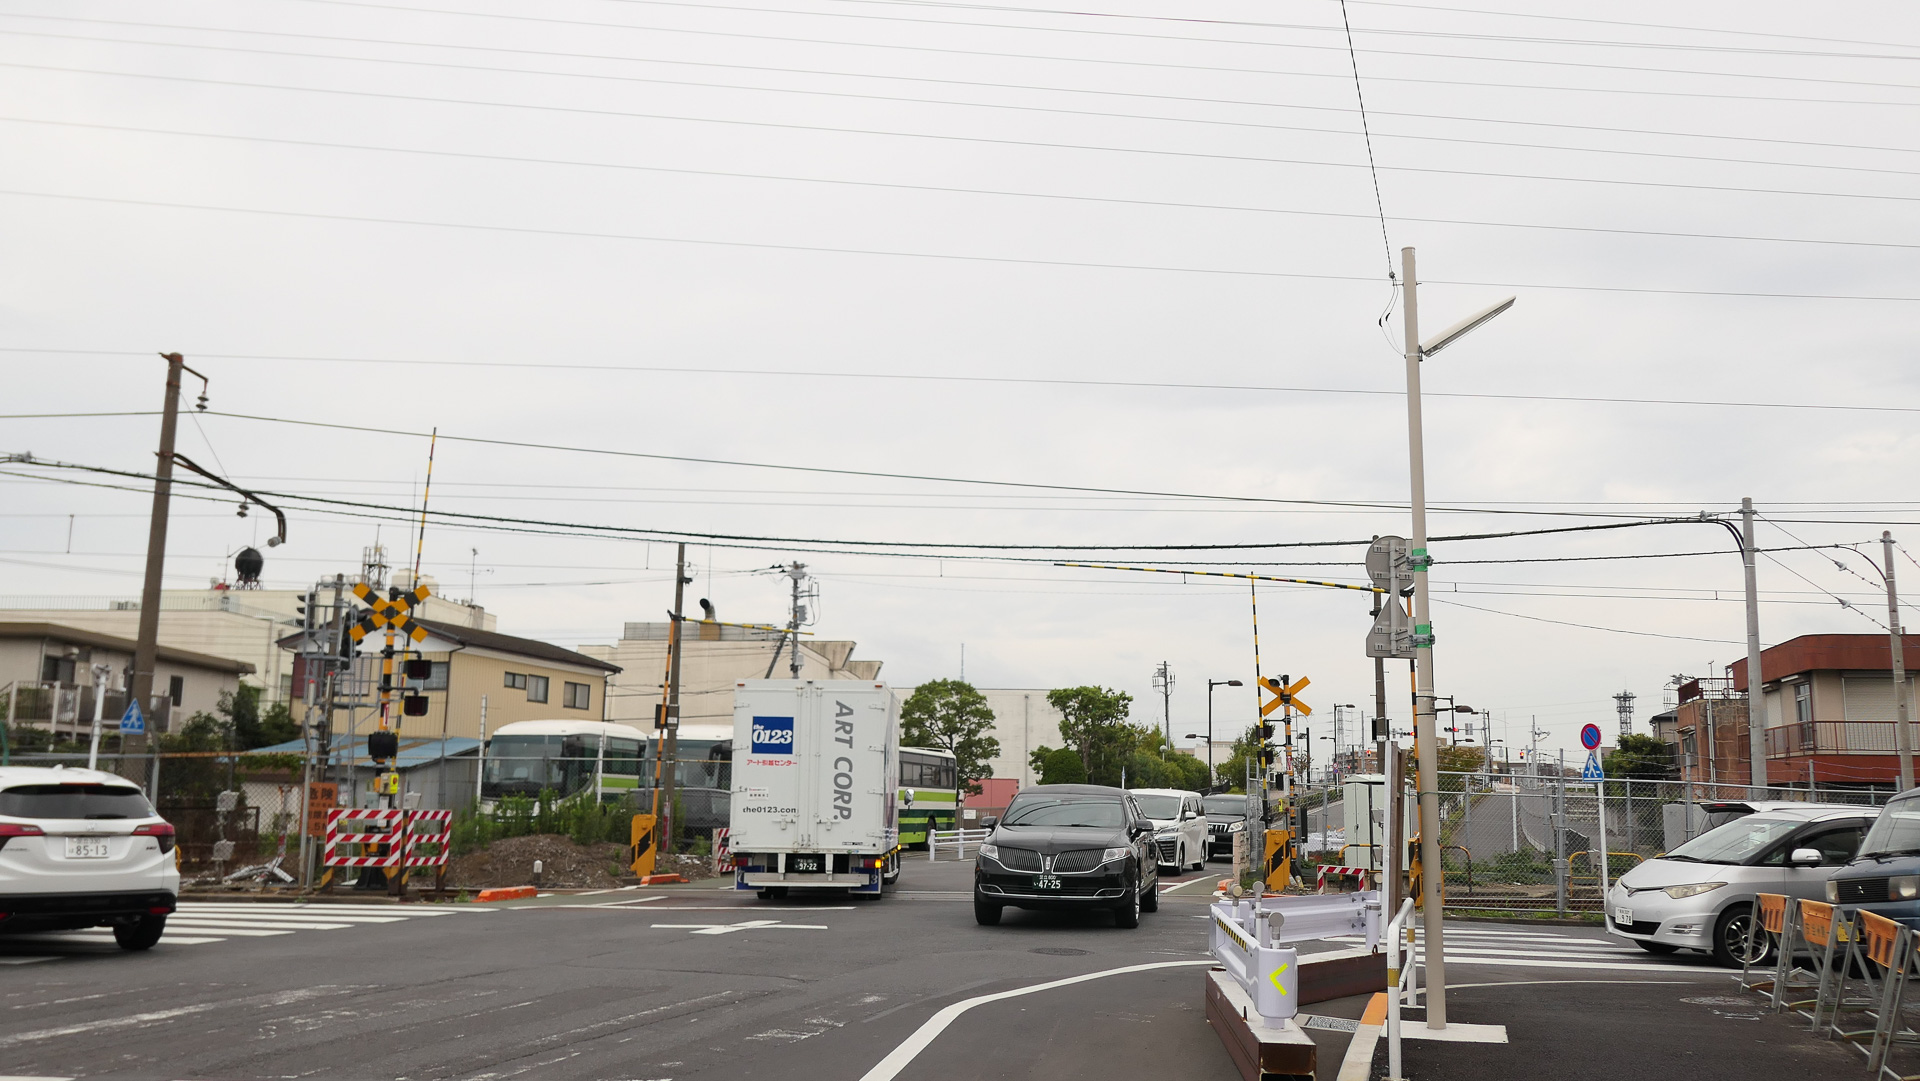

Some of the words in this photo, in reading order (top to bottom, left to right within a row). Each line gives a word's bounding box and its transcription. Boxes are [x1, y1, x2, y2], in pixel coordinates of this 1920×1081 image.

[835, 700, 854, 749] ART
[752, 729, 793, 744] 0123
[833, 757, 853, 820] CORP.
[76, 845, 107, 856] 85-13
[1038, 880, 1061, 889] 47-25
